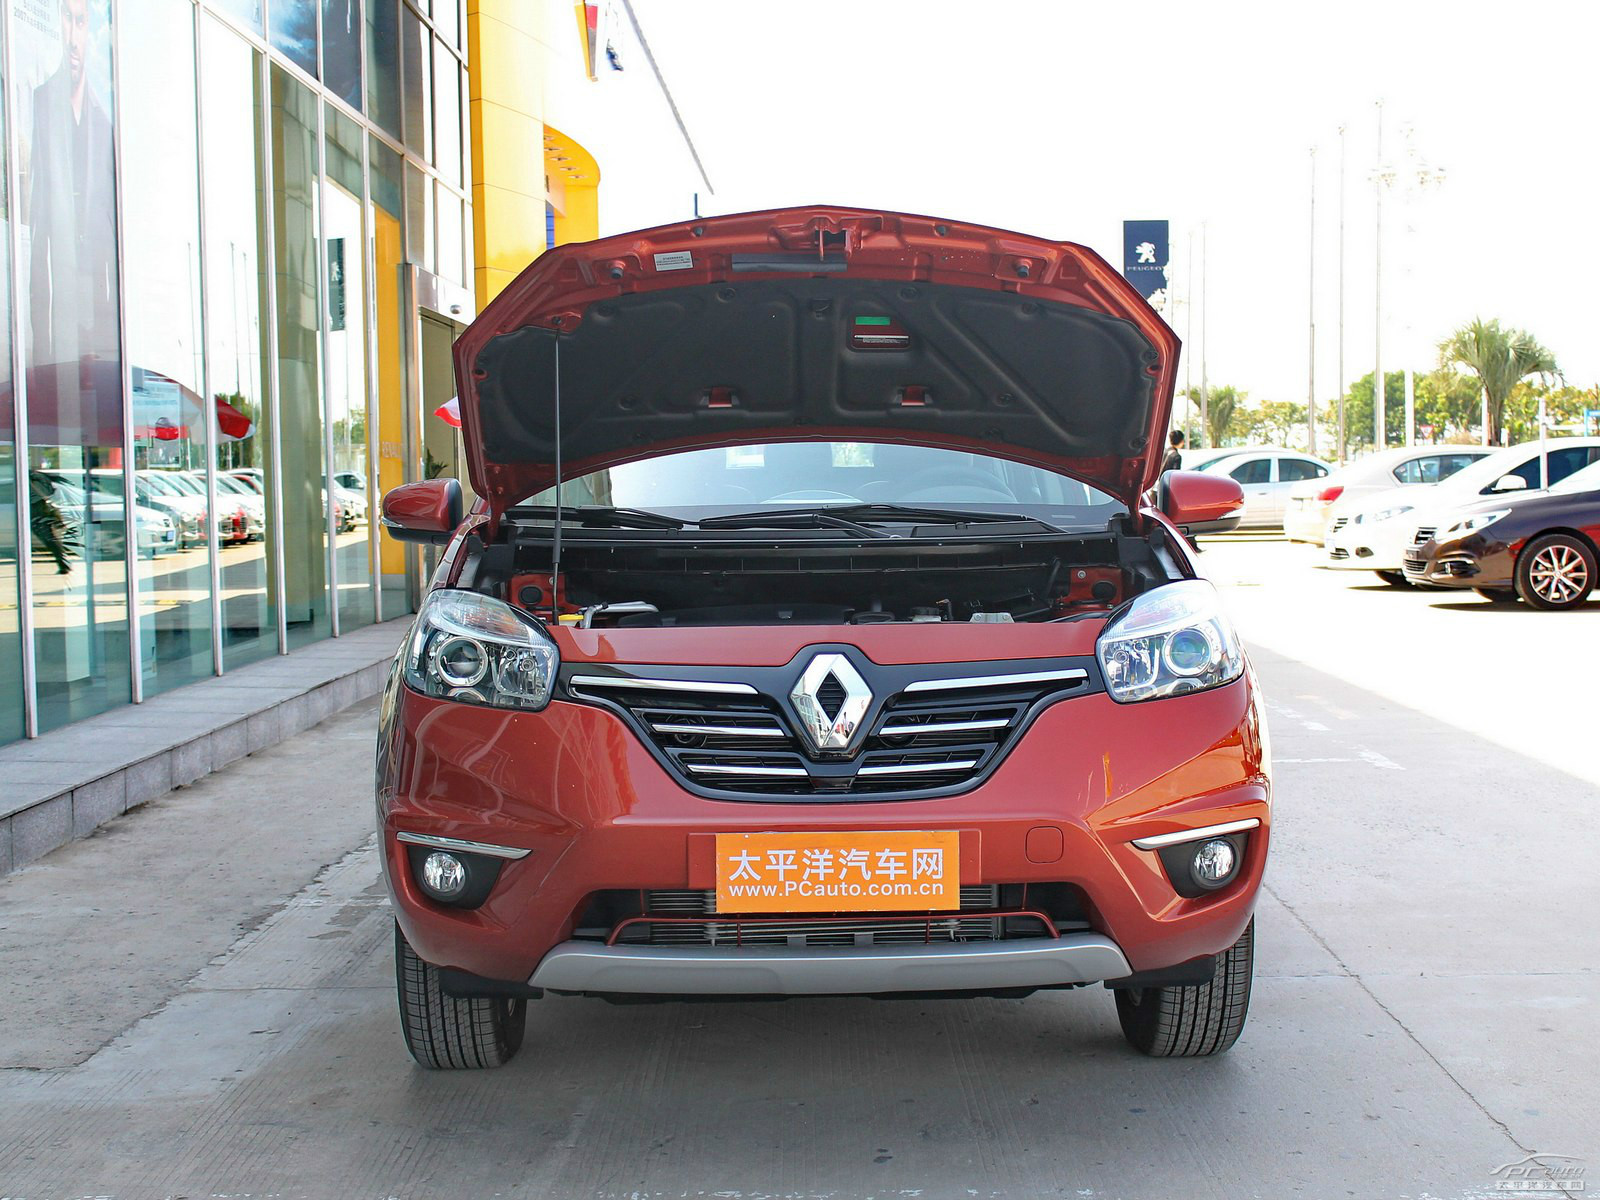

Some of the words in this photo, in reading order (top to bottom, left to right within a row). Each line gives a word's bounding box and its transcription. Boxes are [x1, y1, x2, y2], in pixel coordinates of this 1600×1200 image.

[728, 848, 943, 881] 太平洋汽车网
[728, 880, 943, 896] www.PCauto.com.cn
